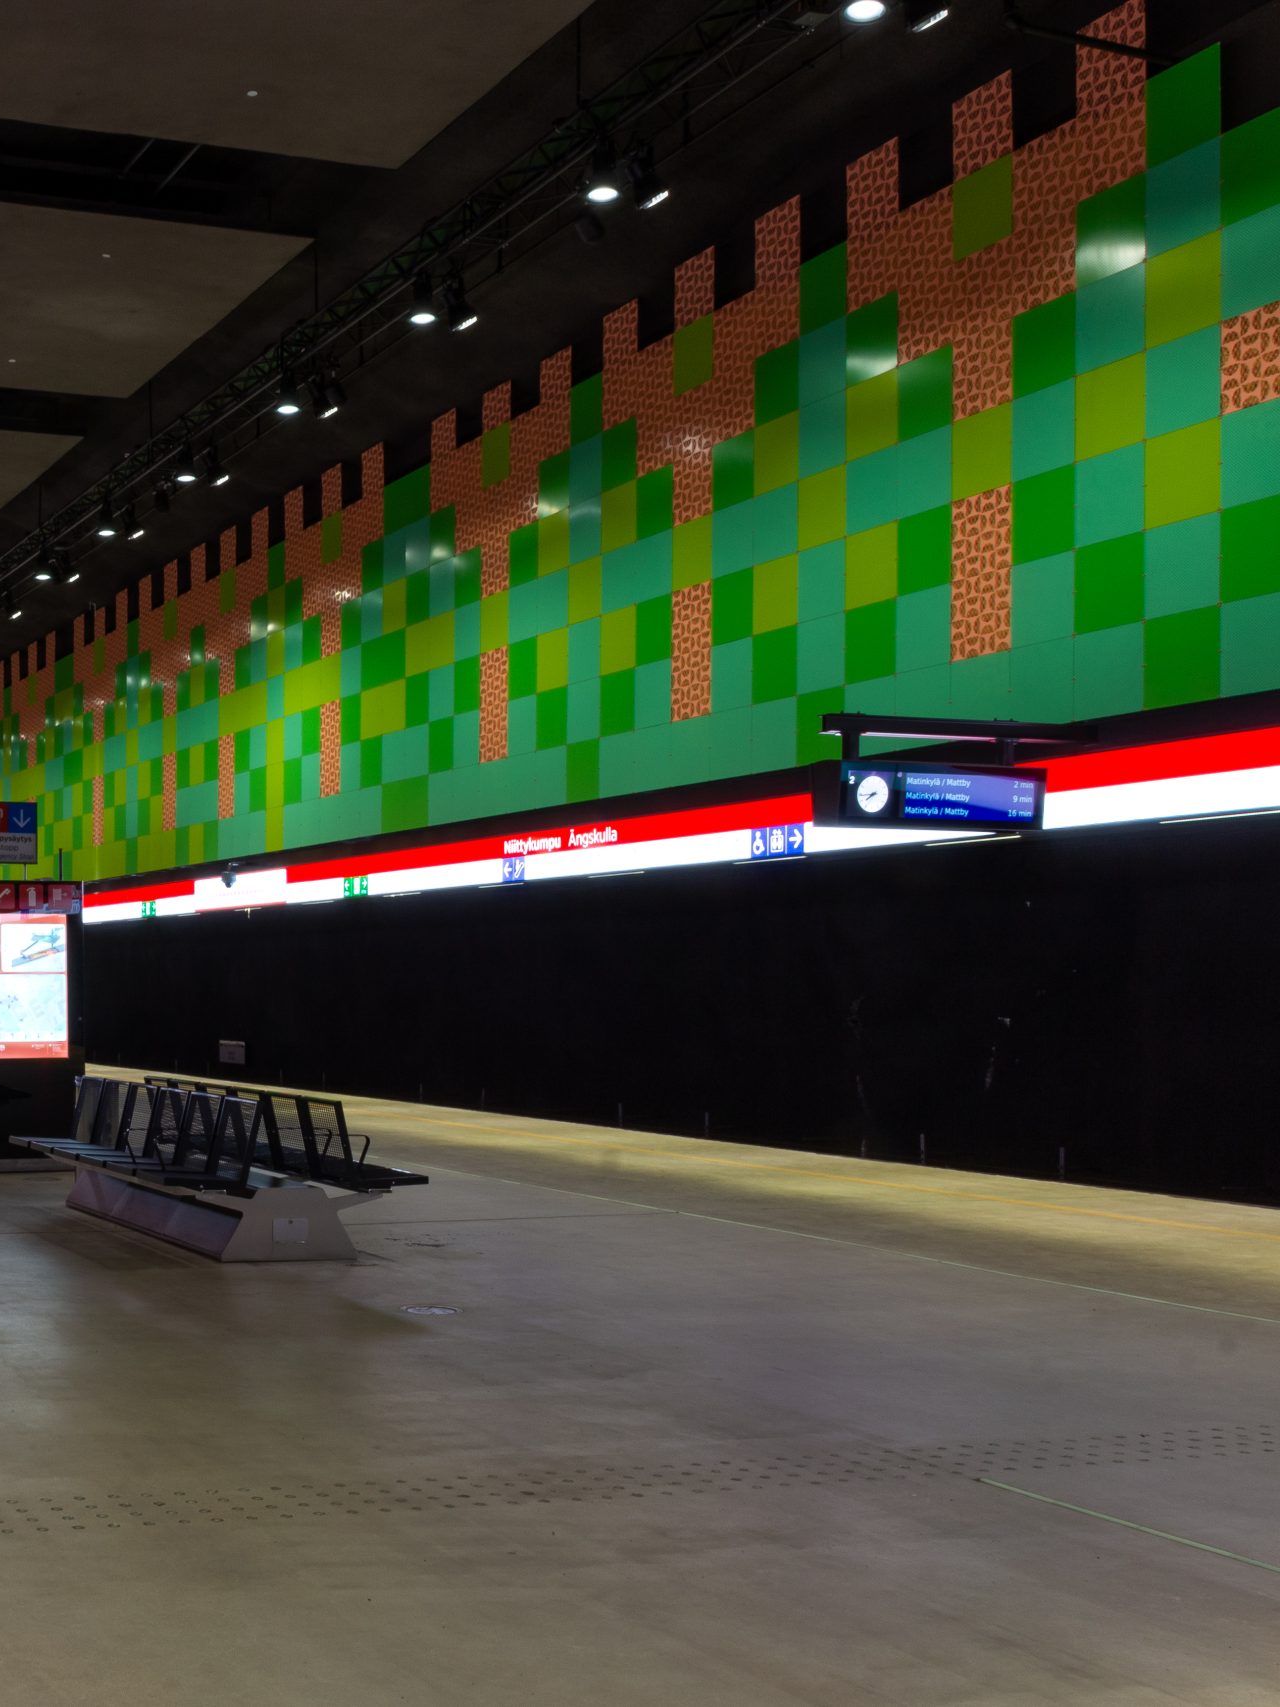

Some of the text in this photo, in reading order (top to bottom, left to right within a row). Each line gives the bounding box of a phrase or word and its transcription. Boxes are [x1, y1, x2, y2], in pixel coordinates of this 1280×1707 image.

[848, 775, 856, 785] 2
[906, 776, 941, 788] Matinkylä
[946, 777, 972, 788] Mattby
[1013, 780, 1034, 789] 2 min
[945, 792, 970, 803] Mattby
[1019, 795, 1033, 803] min
[944, 807, 969, 818] Mattby
[1018, 810, 1032, 818] min
[503, 826, 618, 855] Niittykumpu Ängskulla
